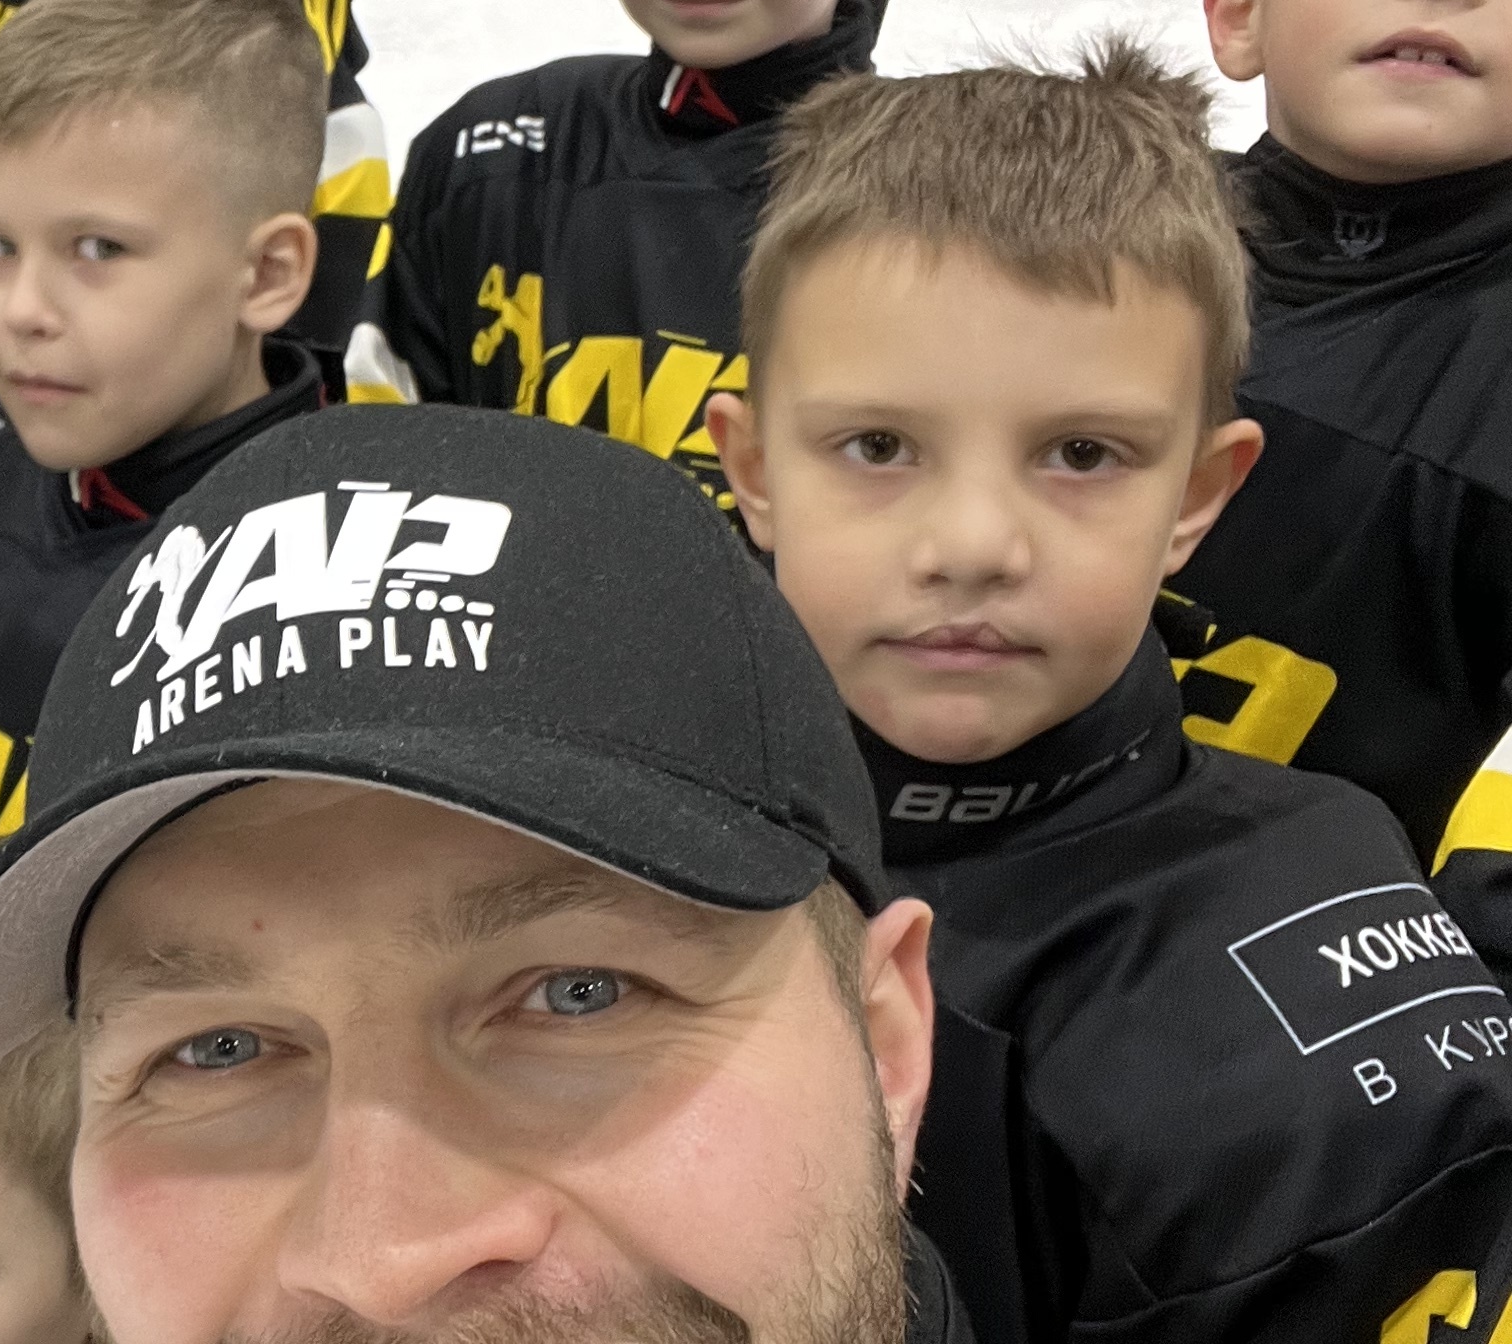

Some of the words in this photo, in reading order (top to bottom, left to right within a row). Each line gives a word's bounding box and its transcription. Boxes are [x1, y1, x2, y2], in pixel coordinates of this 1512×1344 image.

[130, 623, 307, 755] ARENA
[338, 616, 494, 673] PLAY
[1352, 1057, 1398, 1106] В
[1423, 1016, 1512, 1072] КУР
